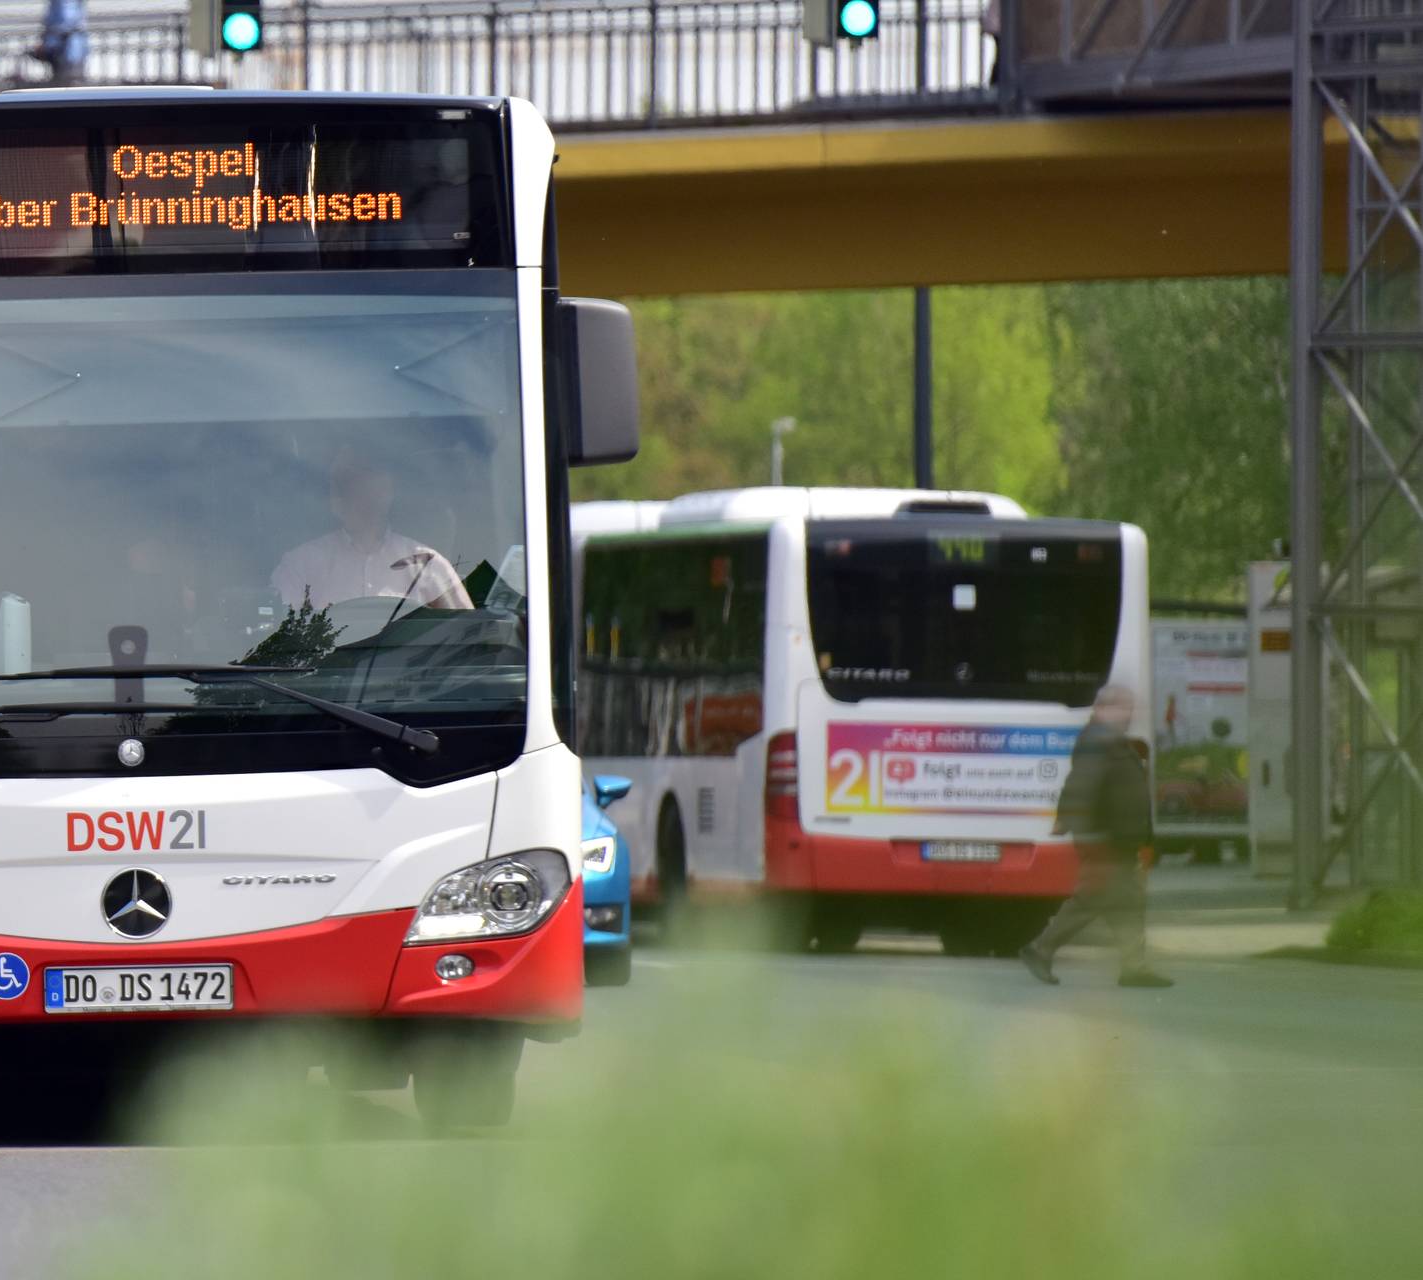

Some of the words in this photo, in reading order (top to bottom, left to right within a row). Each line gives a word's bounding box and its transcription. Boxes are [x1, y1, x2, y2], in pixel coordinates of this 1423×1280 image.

[112, 142, 255, 189] Oespel
[71, 189, 402, 231] Brünninghausen
[1009, 731, 1044, 748] dem
[923, 759, 961, 779] folgt
[66, 810, 206, 852] DSW21
[222, 874, 338, 886] CITARO
[64, 974, 97, 1003] DO
[119, 973, 152, 1001] DS
[160, 971, 226, 1001] 1472
